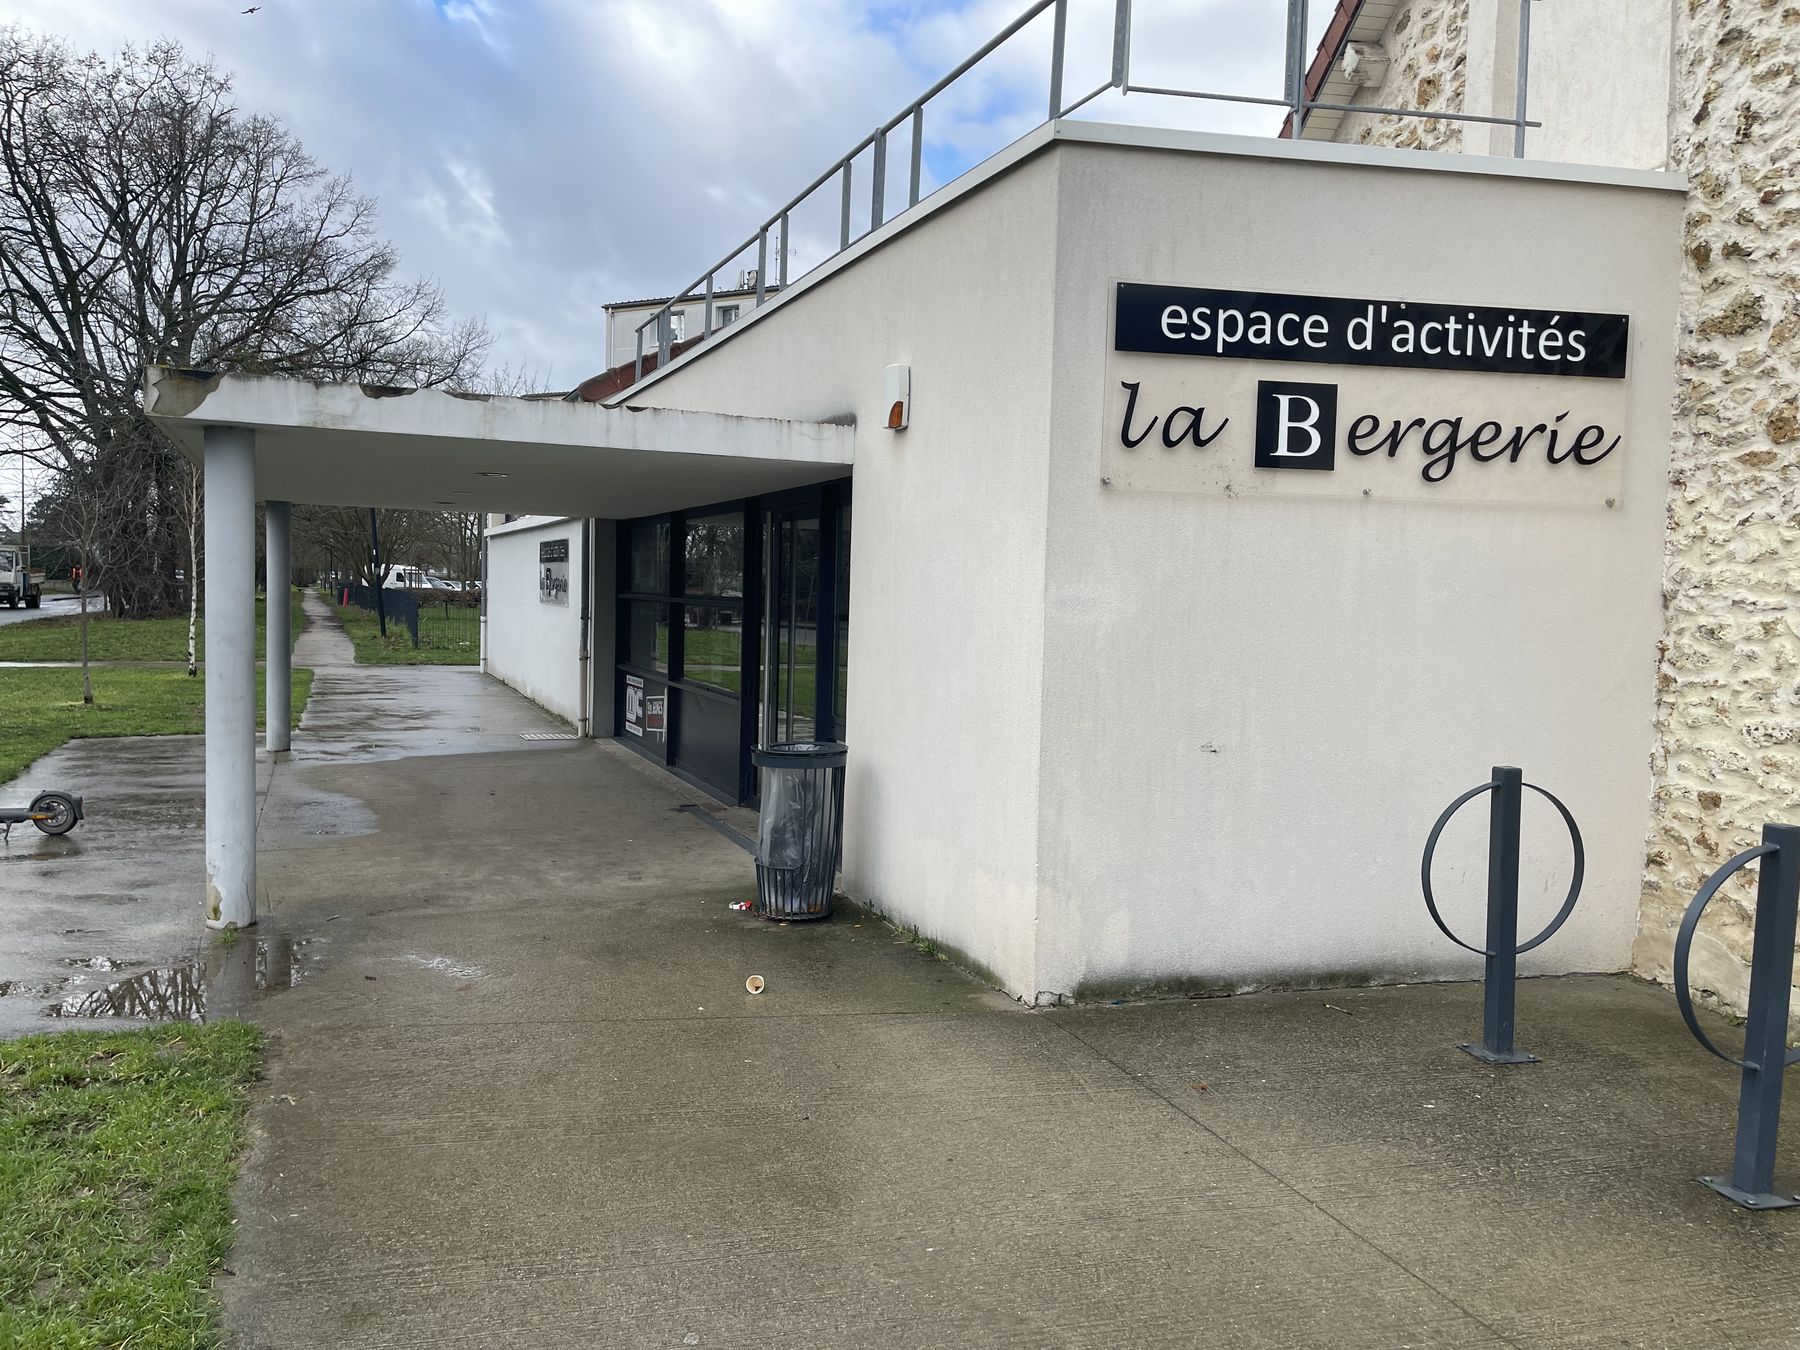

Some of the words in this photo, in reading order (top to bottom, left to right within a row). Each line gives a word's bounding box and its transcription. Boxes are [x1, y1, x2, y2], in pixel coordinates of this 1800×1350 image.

[1160, 302, 1329, 353] espace
[1346, 304, 1587, 362] d'activités
[1120, 380, 1230, 450] la
[1268, 392, 1622, 483] Bergerie
